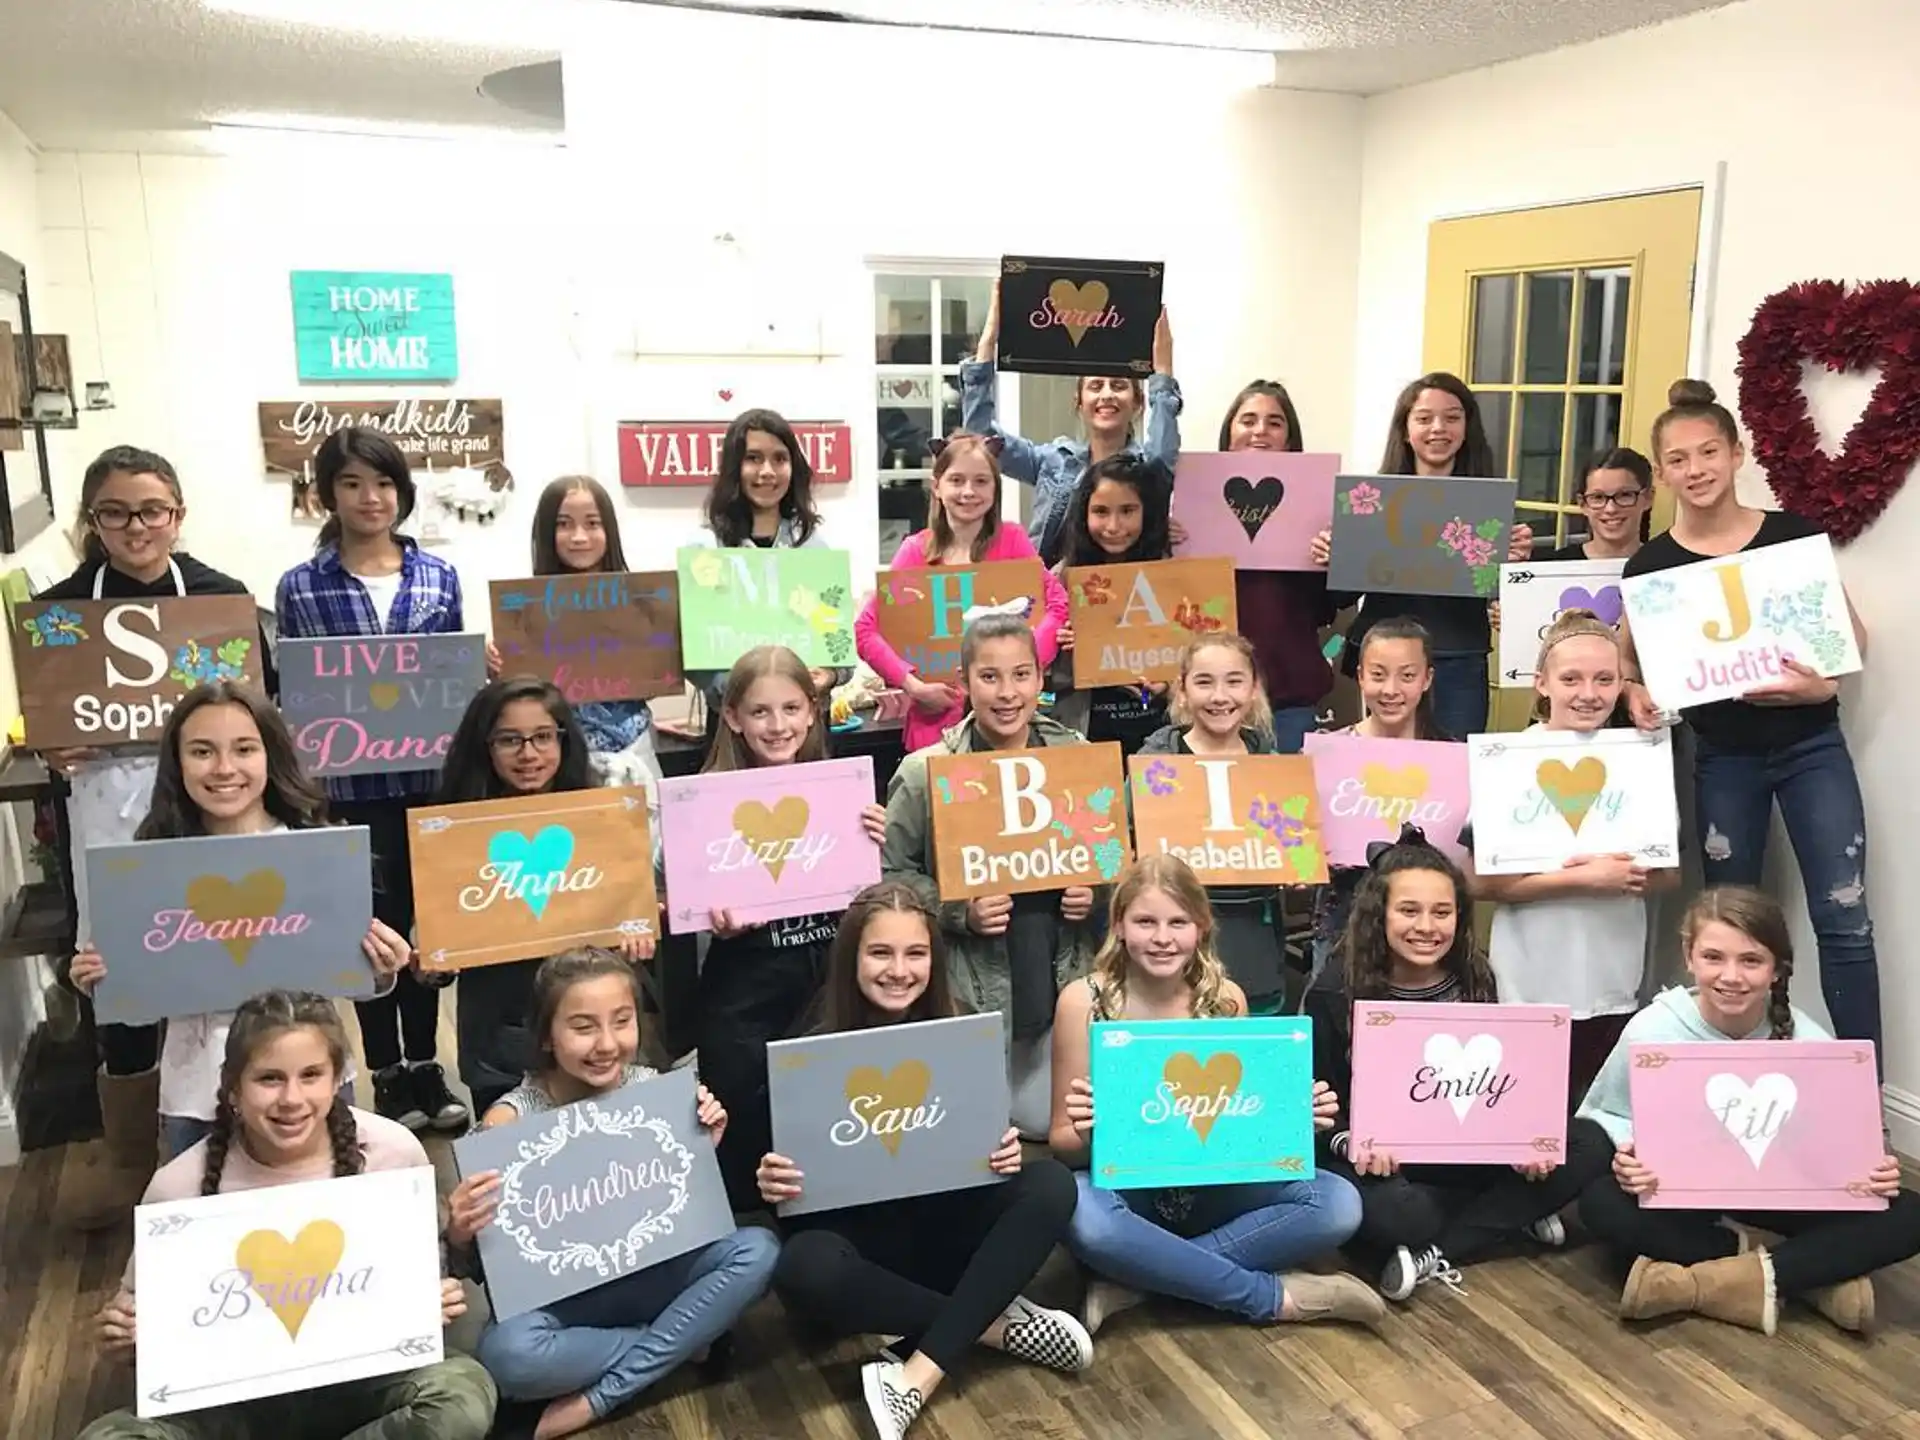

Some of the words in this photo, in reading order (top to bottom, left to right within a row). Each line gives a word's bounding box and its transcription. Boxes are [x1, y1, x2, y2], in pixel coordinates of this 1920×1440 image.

[328, 285, 421, 312] HOME
[1029, 297, 1126, 329] Sarah
[330, 335, 430, 370] HOME
[280, 400, 475, 445] Grandkids
[428, 436, 449, 451] life
[451, 436, 489, 454] grand
[725, 554, 781, 609] M
[926, 571, 979, 640] H
[1117, 568, 1171, 629] A
[1701, 562, 1752, 643] J
[102, 603, 169, 689] S
[313, 641, 421, 677] LIVE
[554, 661, 632, 703] love
[73, 693, 185, 741] Soph
[296, 716, 454, 772] Danc
[991, 756, 1054, 837] B
[1194, 759, 1245, 832] I
[1329, 776, 1453, 824] Emma
[706, 831, 838, 874] Lizzy
[961, 837, 1090, 887] Brooke
[1159, 836, 1283, 871] Isabella
[458, 860, 604, 912] Anna
[144, 908, 313, 952] Jeanna
[1140, 1080, 1264, 1132] Sophie
[1409, 1064, 1518, 1109] Emily
[829, 1093, 947, 1147] Savi
[516, 1157, 674, 1230] Aundrea
[192, 1265, 375, 1328] Briana
